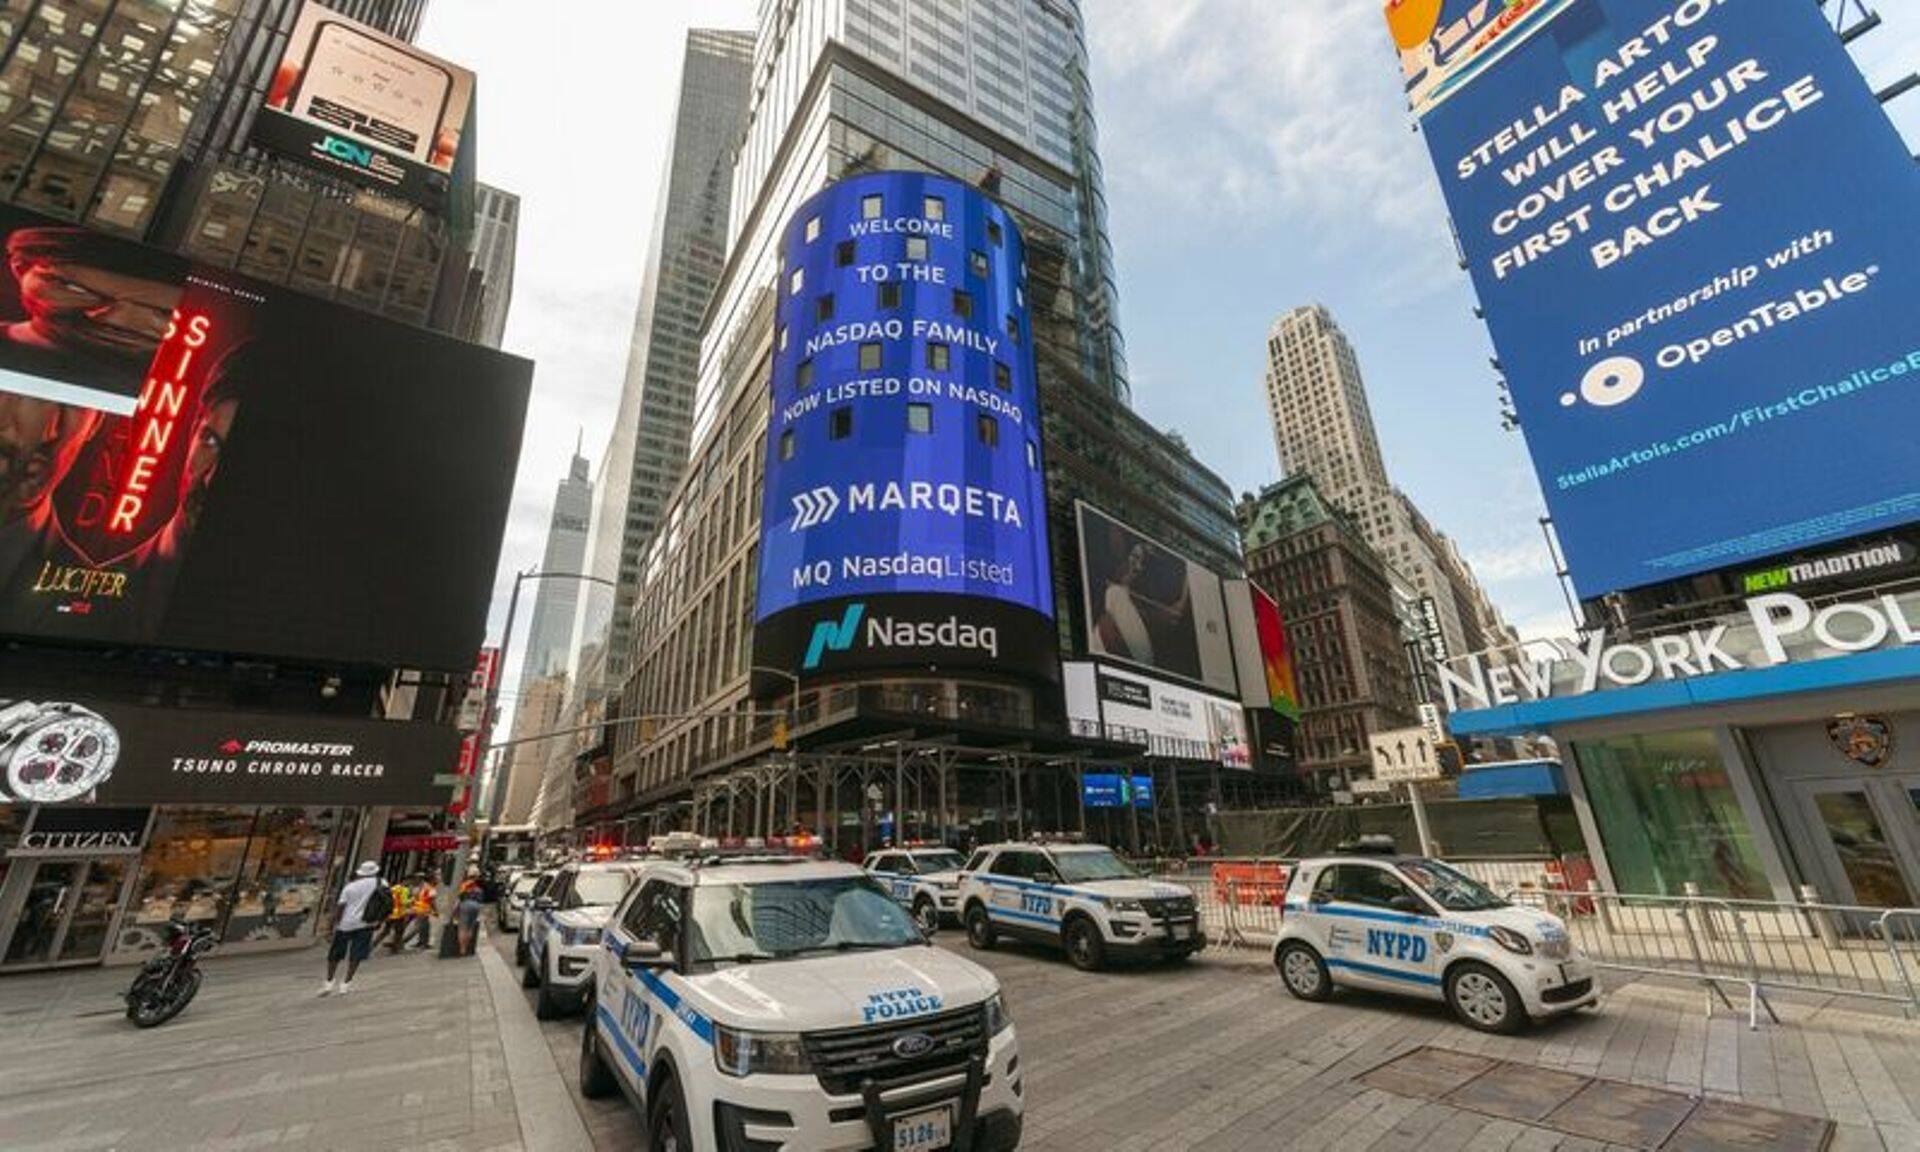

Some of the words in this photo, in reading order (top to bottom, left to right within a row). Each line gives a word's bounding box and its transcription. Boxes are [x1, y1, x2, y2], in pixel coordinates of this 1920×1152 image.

[1457, 85, 1586, 179] STELLA
[1595, 0, 1727, 89] ARTO
[1501, 122, 1597, 187] WILL
[1602, 34, 1719, 124] HELP
[1492, 146, 1625, 236] COVER
[1628, 58, 1769, 149] YOUR
[1492, 204, 1592, 279] FIRST
[1604, 75, 1824, 213] CHALICE
[850, 217, 953, 239] WELCOME
[1590, 183, 1723, 269] BACK
[857, 264, 889, 284] TO
[895, 263, 946, 285] THE
[1579, 338, 1600, 356] In
[1606, 264, 1759, 347] partnership
[1765, 229, 1834, 270] with
[806, 319, 903, 357] NASDAQ
[913, 318, 998, 356] FAMILY
[783, 392, 821, 424] NOW
[827, 377, 900, 404] LISTED
[908, 377, 941, 396] ON
[949, 383, 1023, 425] NASDAQ
[109, 315, 210, 533] SINNER
[848, 481, 1022, 528] MARQETA
[33, 560, 127, 599] LUCIFER
[793, 560, 832, 590] MQ
[866, 615, 998, 658] Nasdaq
[1437, 652, 1556, 711] NEW
[1556, 625, 1745, 694] YORK
[172, 757, 238, 773] TSUNO
[247, 761, 322, 776] CHRONO
[331, 763, 385, 777] RACER
[245, 740, 354, 756] PROMASTER
[24, 831, 139, 848] CITIZEN
[1366, 926, 1427, 962] NYPD
[863, 996, 942, 1022] POLICE
[868, 988, 922, 1003] NYPD
